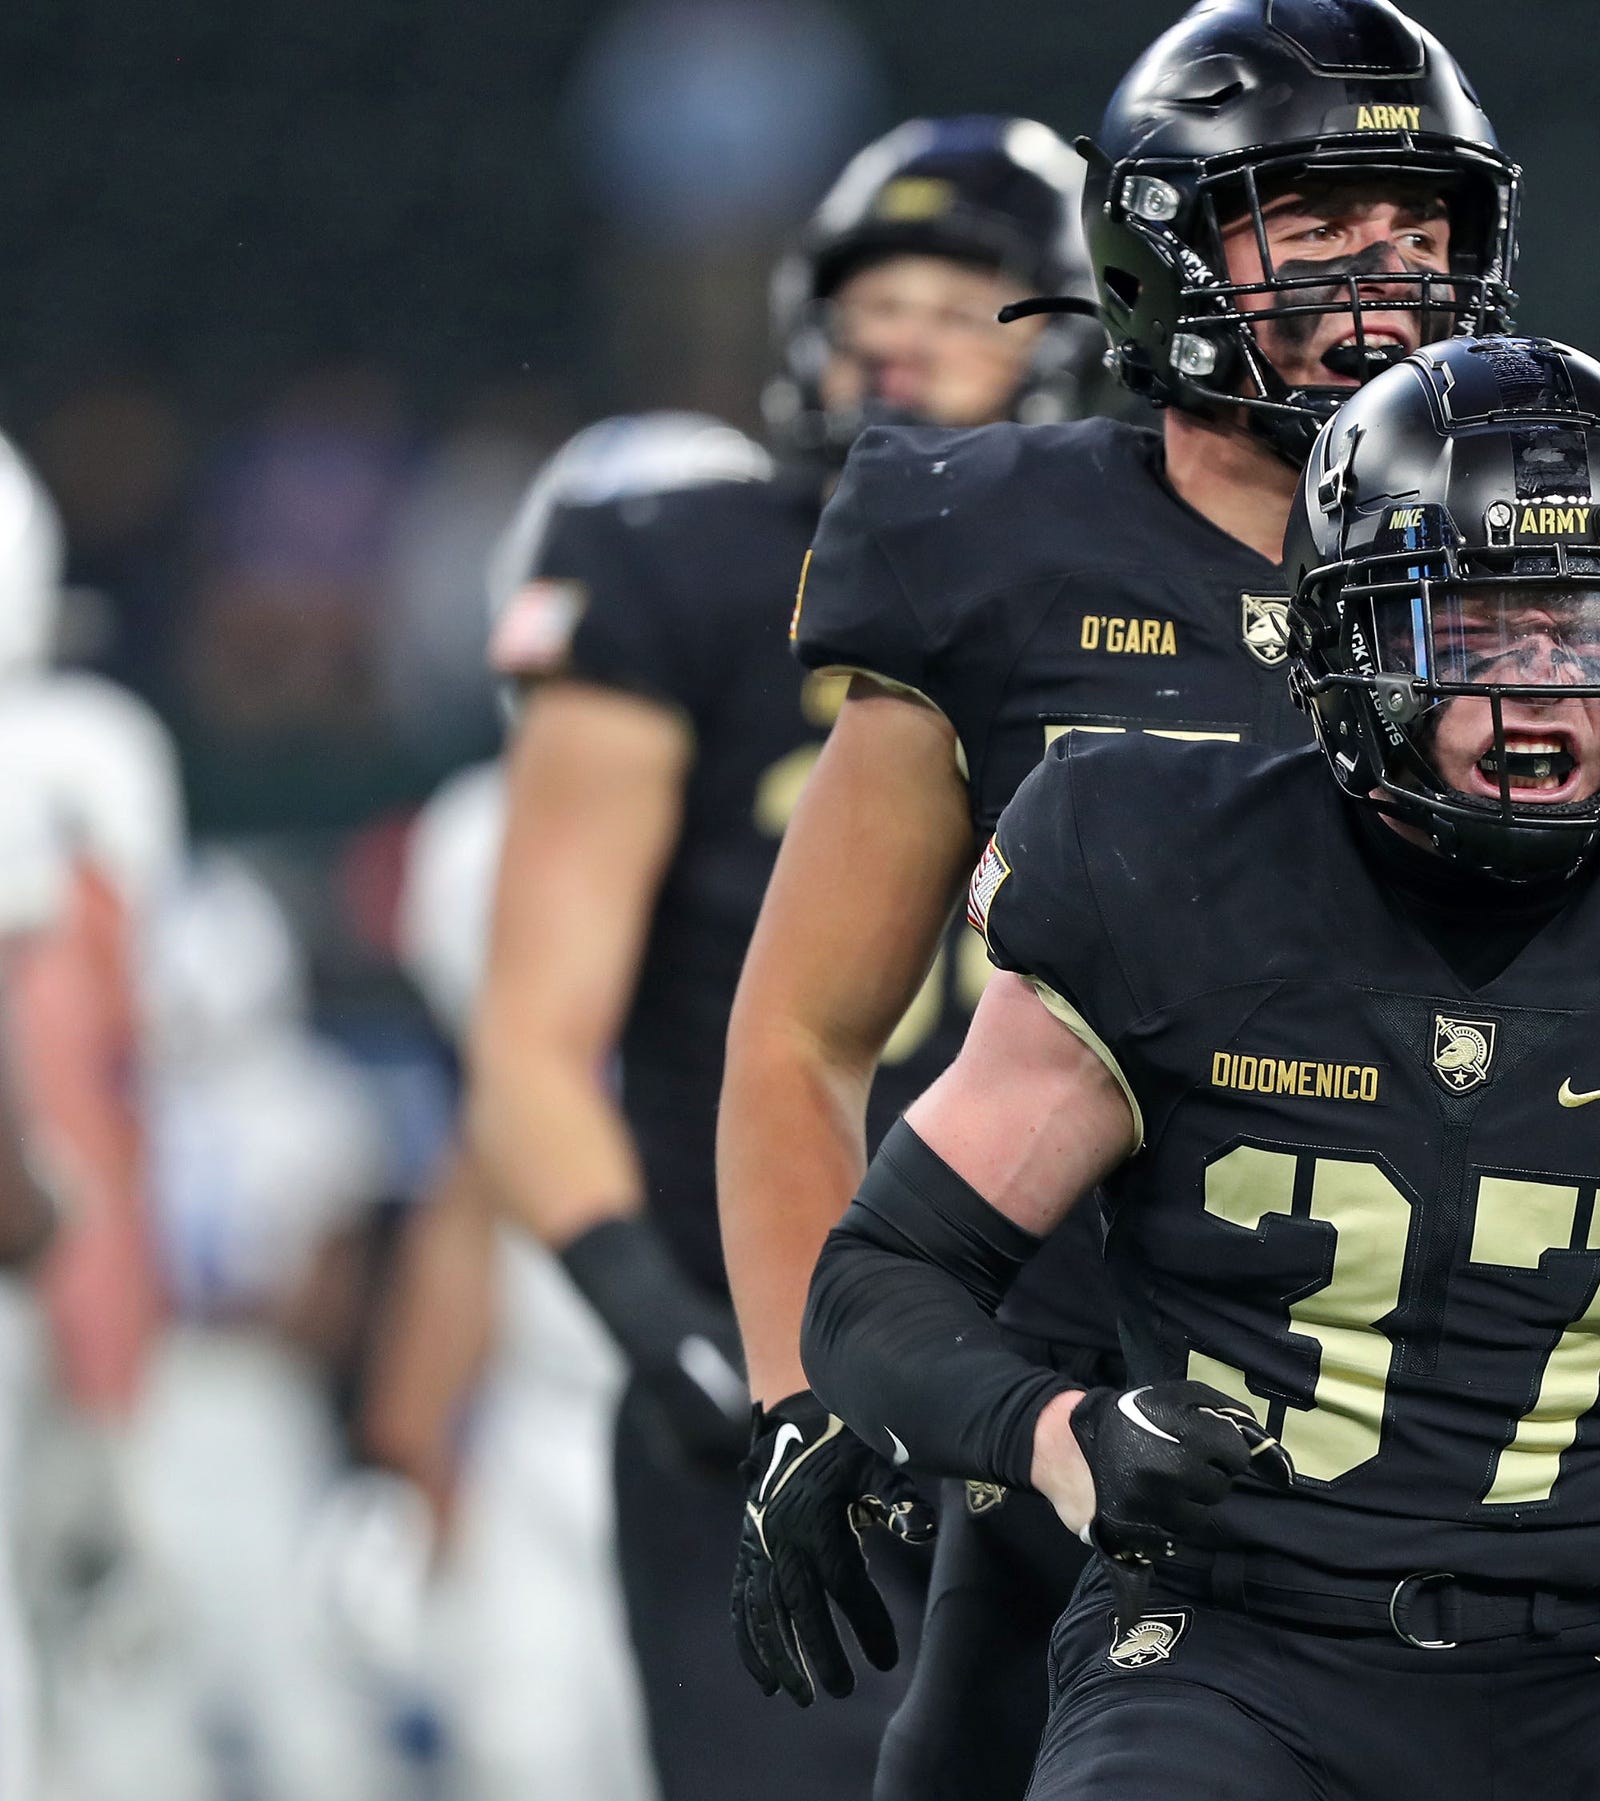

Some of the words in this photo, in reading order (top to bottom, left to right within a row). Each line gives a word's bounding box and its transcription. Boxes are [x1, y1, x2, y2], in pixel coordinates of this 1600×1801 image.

[1357, 105, 1420, 130] ARMY
[1389, 507, 1425, 529] NIKE
[1519, 507, 1590, 533] ARMY
[1080, 615, 1178, 656] O'GARA
[1211, 1051, 1379, 1102] DIDOMENICO
